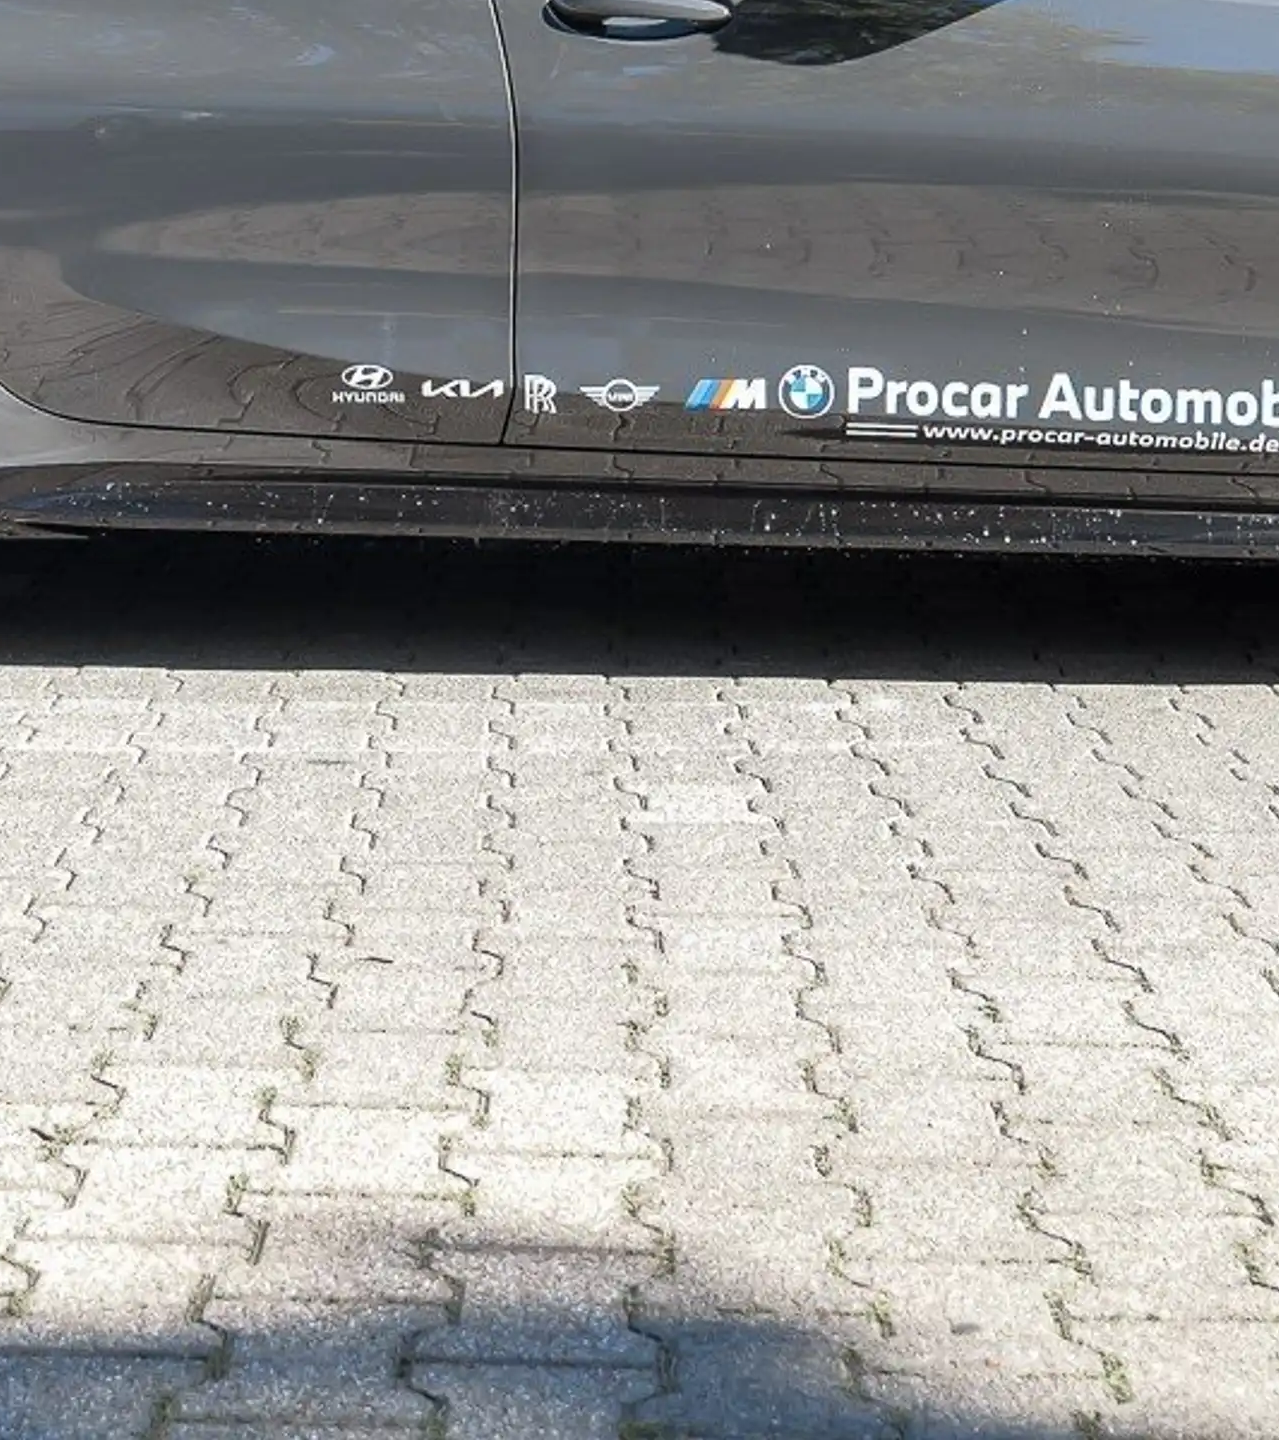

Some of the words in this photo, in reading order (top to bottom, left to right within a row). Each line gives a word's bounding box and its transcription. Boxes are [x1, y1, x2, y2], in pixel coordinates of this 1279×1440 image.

[332, 391, 405, 404] HYUNDAI
[720, 378, 767, 410] M
[847, 366, 1030, 420] Procar
